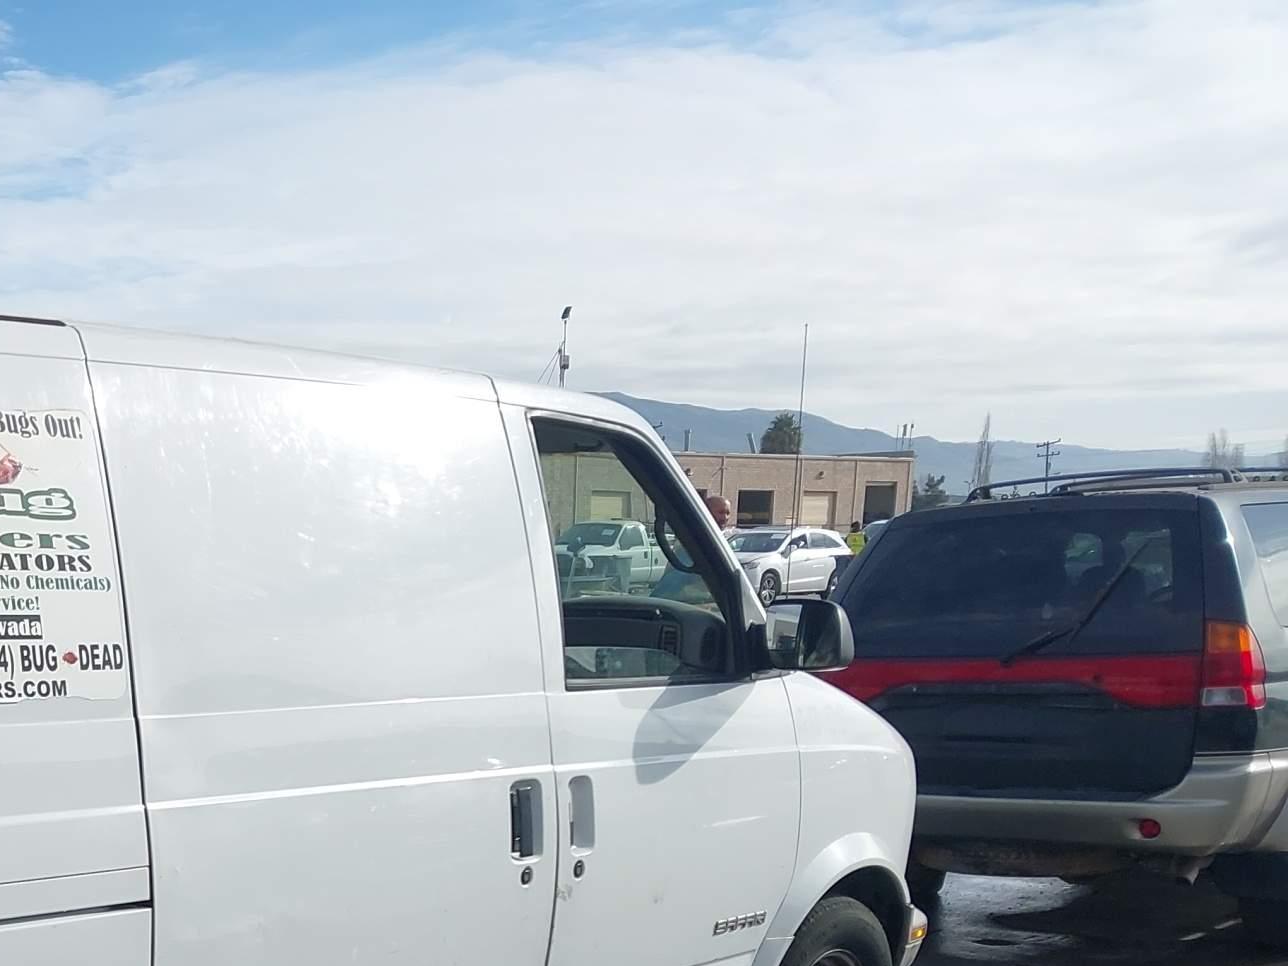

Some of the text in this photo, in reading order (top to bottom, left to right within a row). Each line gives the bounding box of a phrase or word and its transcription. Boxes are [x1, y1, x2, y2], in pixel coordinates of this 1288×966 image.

[45, 414, 83, 439] Out!
[26, 575, 112, 592] Chemicals)
[20, 645, 58, 673] BUG
[79, 643, 124, 671] DEAD
